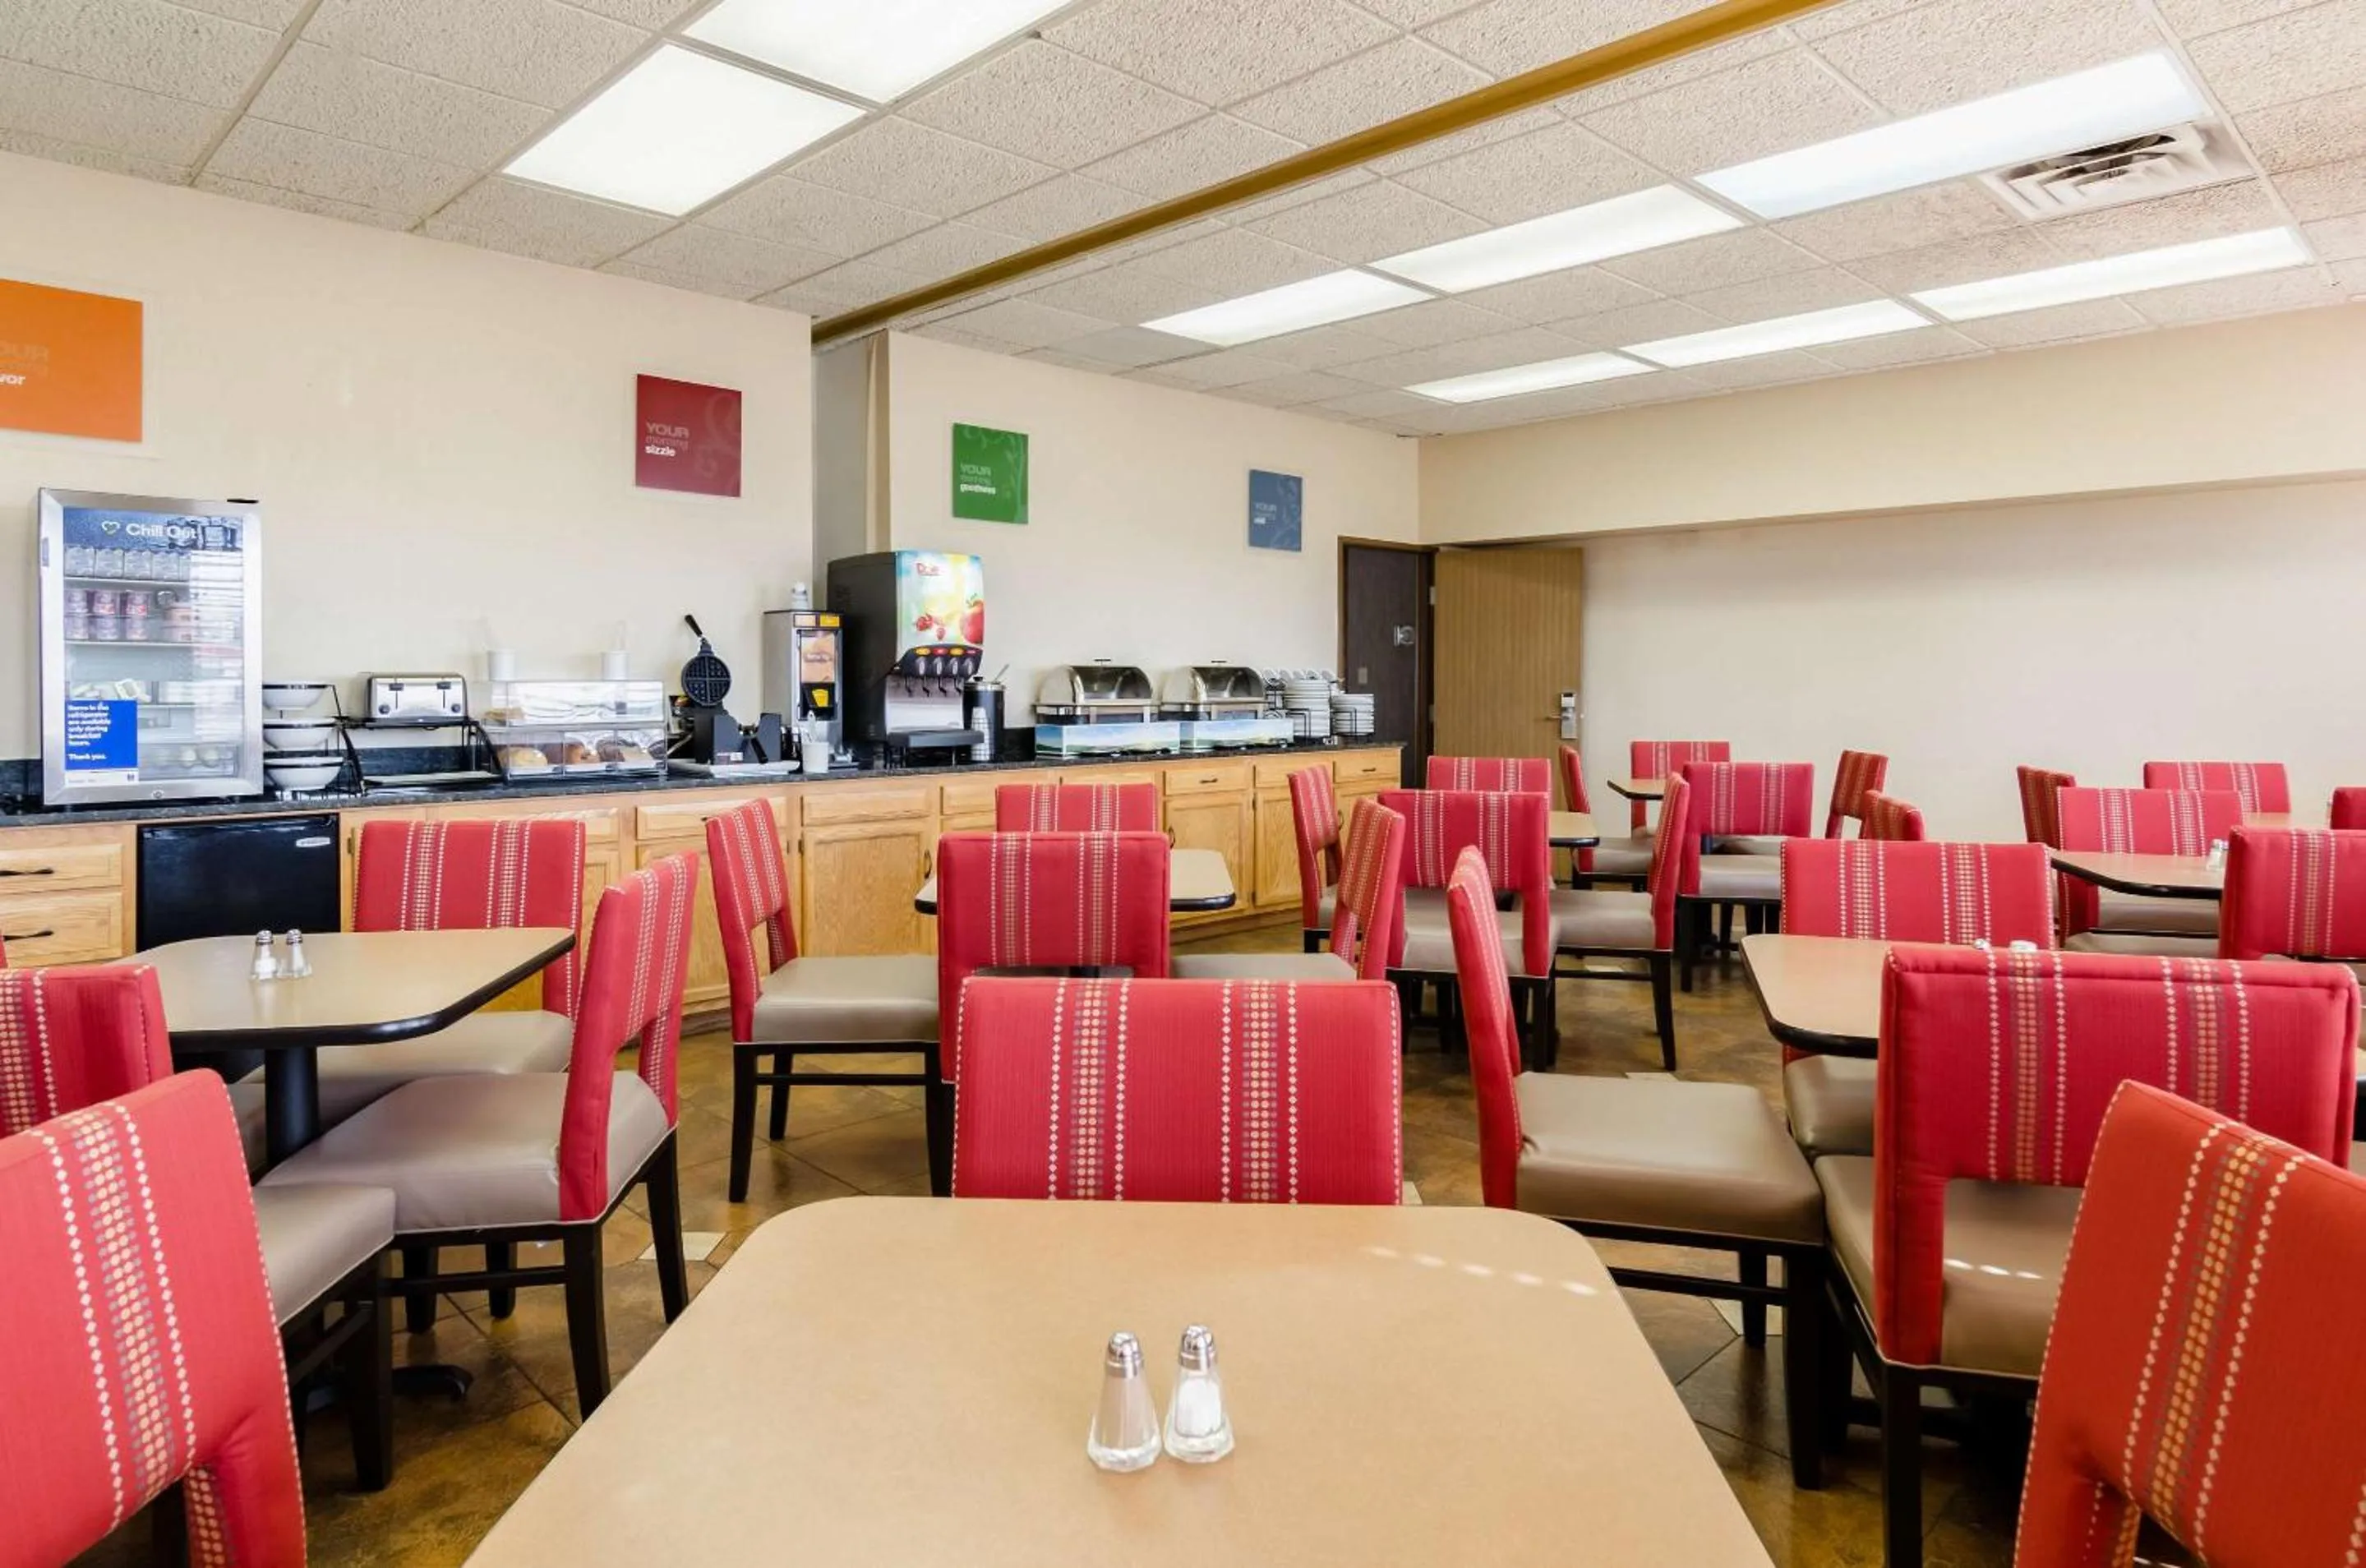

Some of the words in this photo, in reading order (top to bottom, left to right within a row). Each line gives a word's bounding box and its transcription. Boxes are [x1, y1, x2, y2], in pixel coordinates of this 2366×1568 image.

[645, 422, 690, 439] YOUR
[645, 445, 676, 457] sizzle
[960, 462, 992, 477] YOUR
[126, 523, 164, 537] Chill
[167, 525, 197, 539] Out
